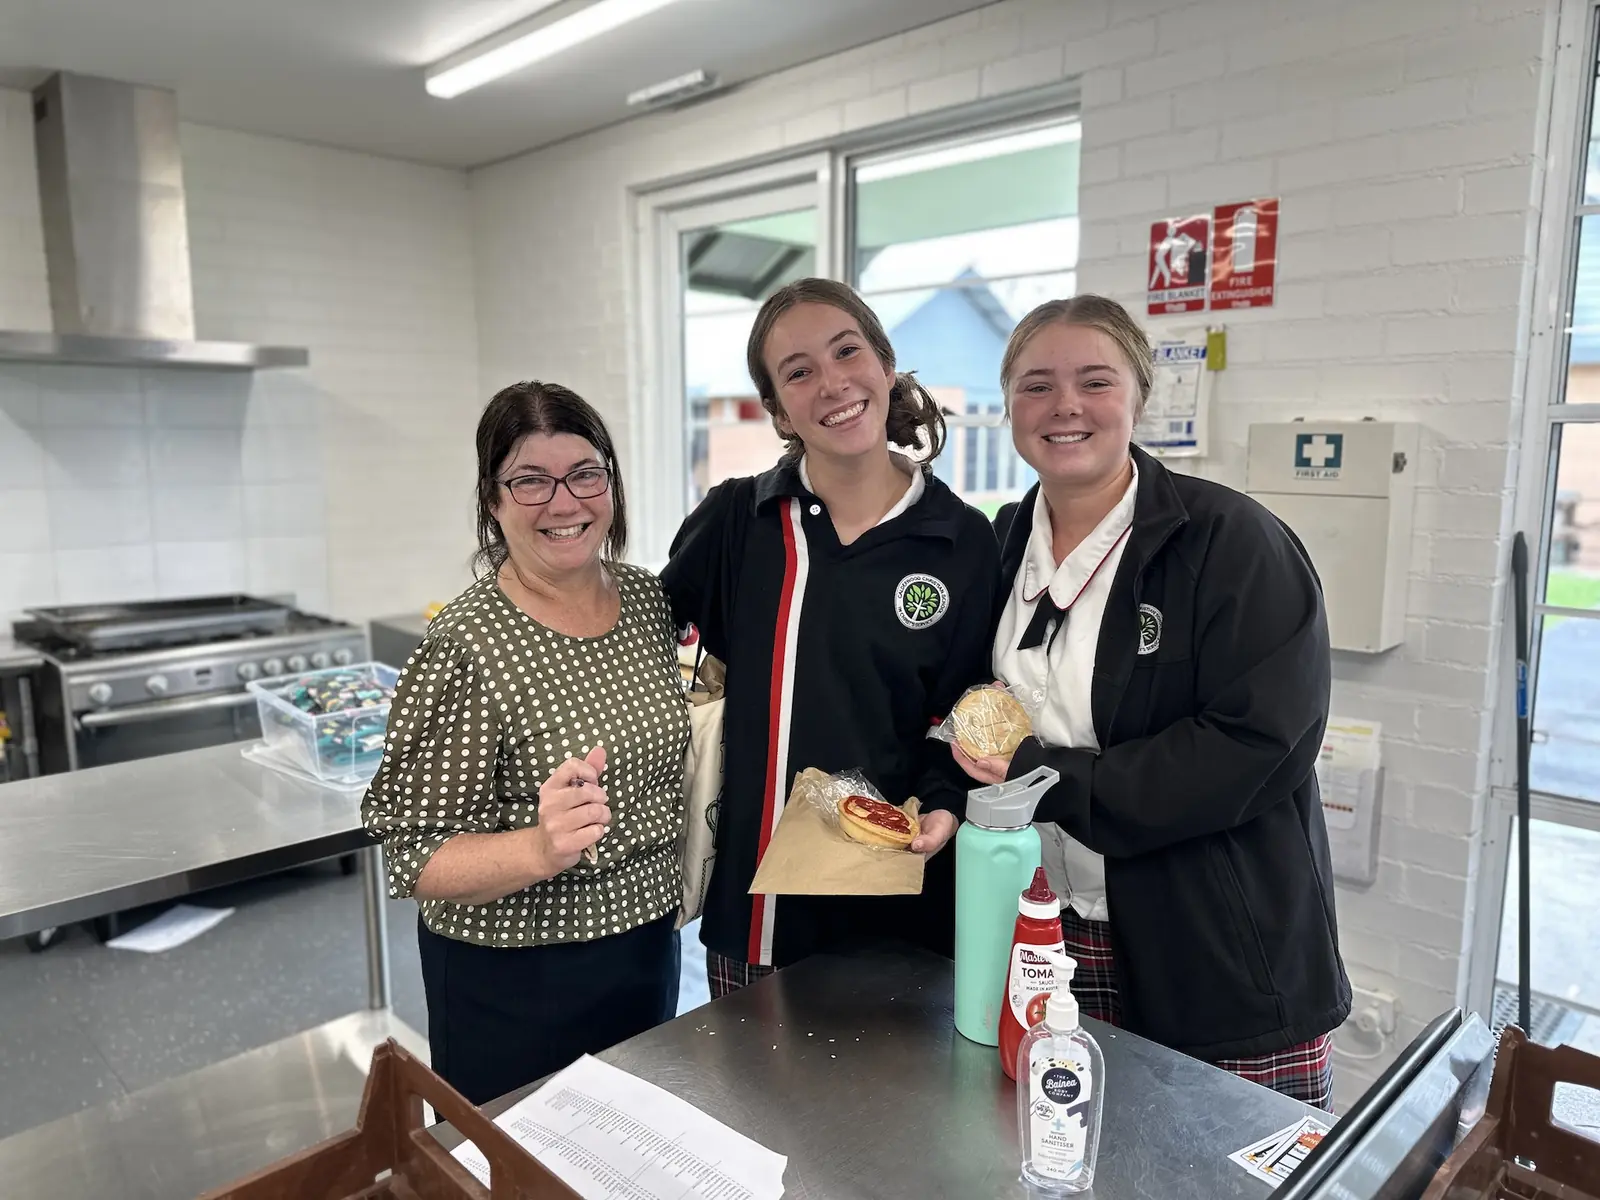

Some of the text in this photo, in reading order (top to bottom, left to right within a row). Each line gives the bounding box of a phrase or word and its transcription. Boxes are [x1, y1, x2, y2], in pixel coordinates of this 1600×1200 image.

[1229, 276, 1253, 287] FIRE
[1147, 287, 1205, 302] FIRE BLANKET
[1211, 286, 1273, 300] EXTINGUISHER
[1296, 470, 1320, 478] FIRST
[1022, 968, 1054, 978] TOMA
[1048, 1090, 1074, 1098] COMPANY
[1041, 1138, 1074, 1148] SANITISER
[1048, 1134, 1068, 1142] HAND
